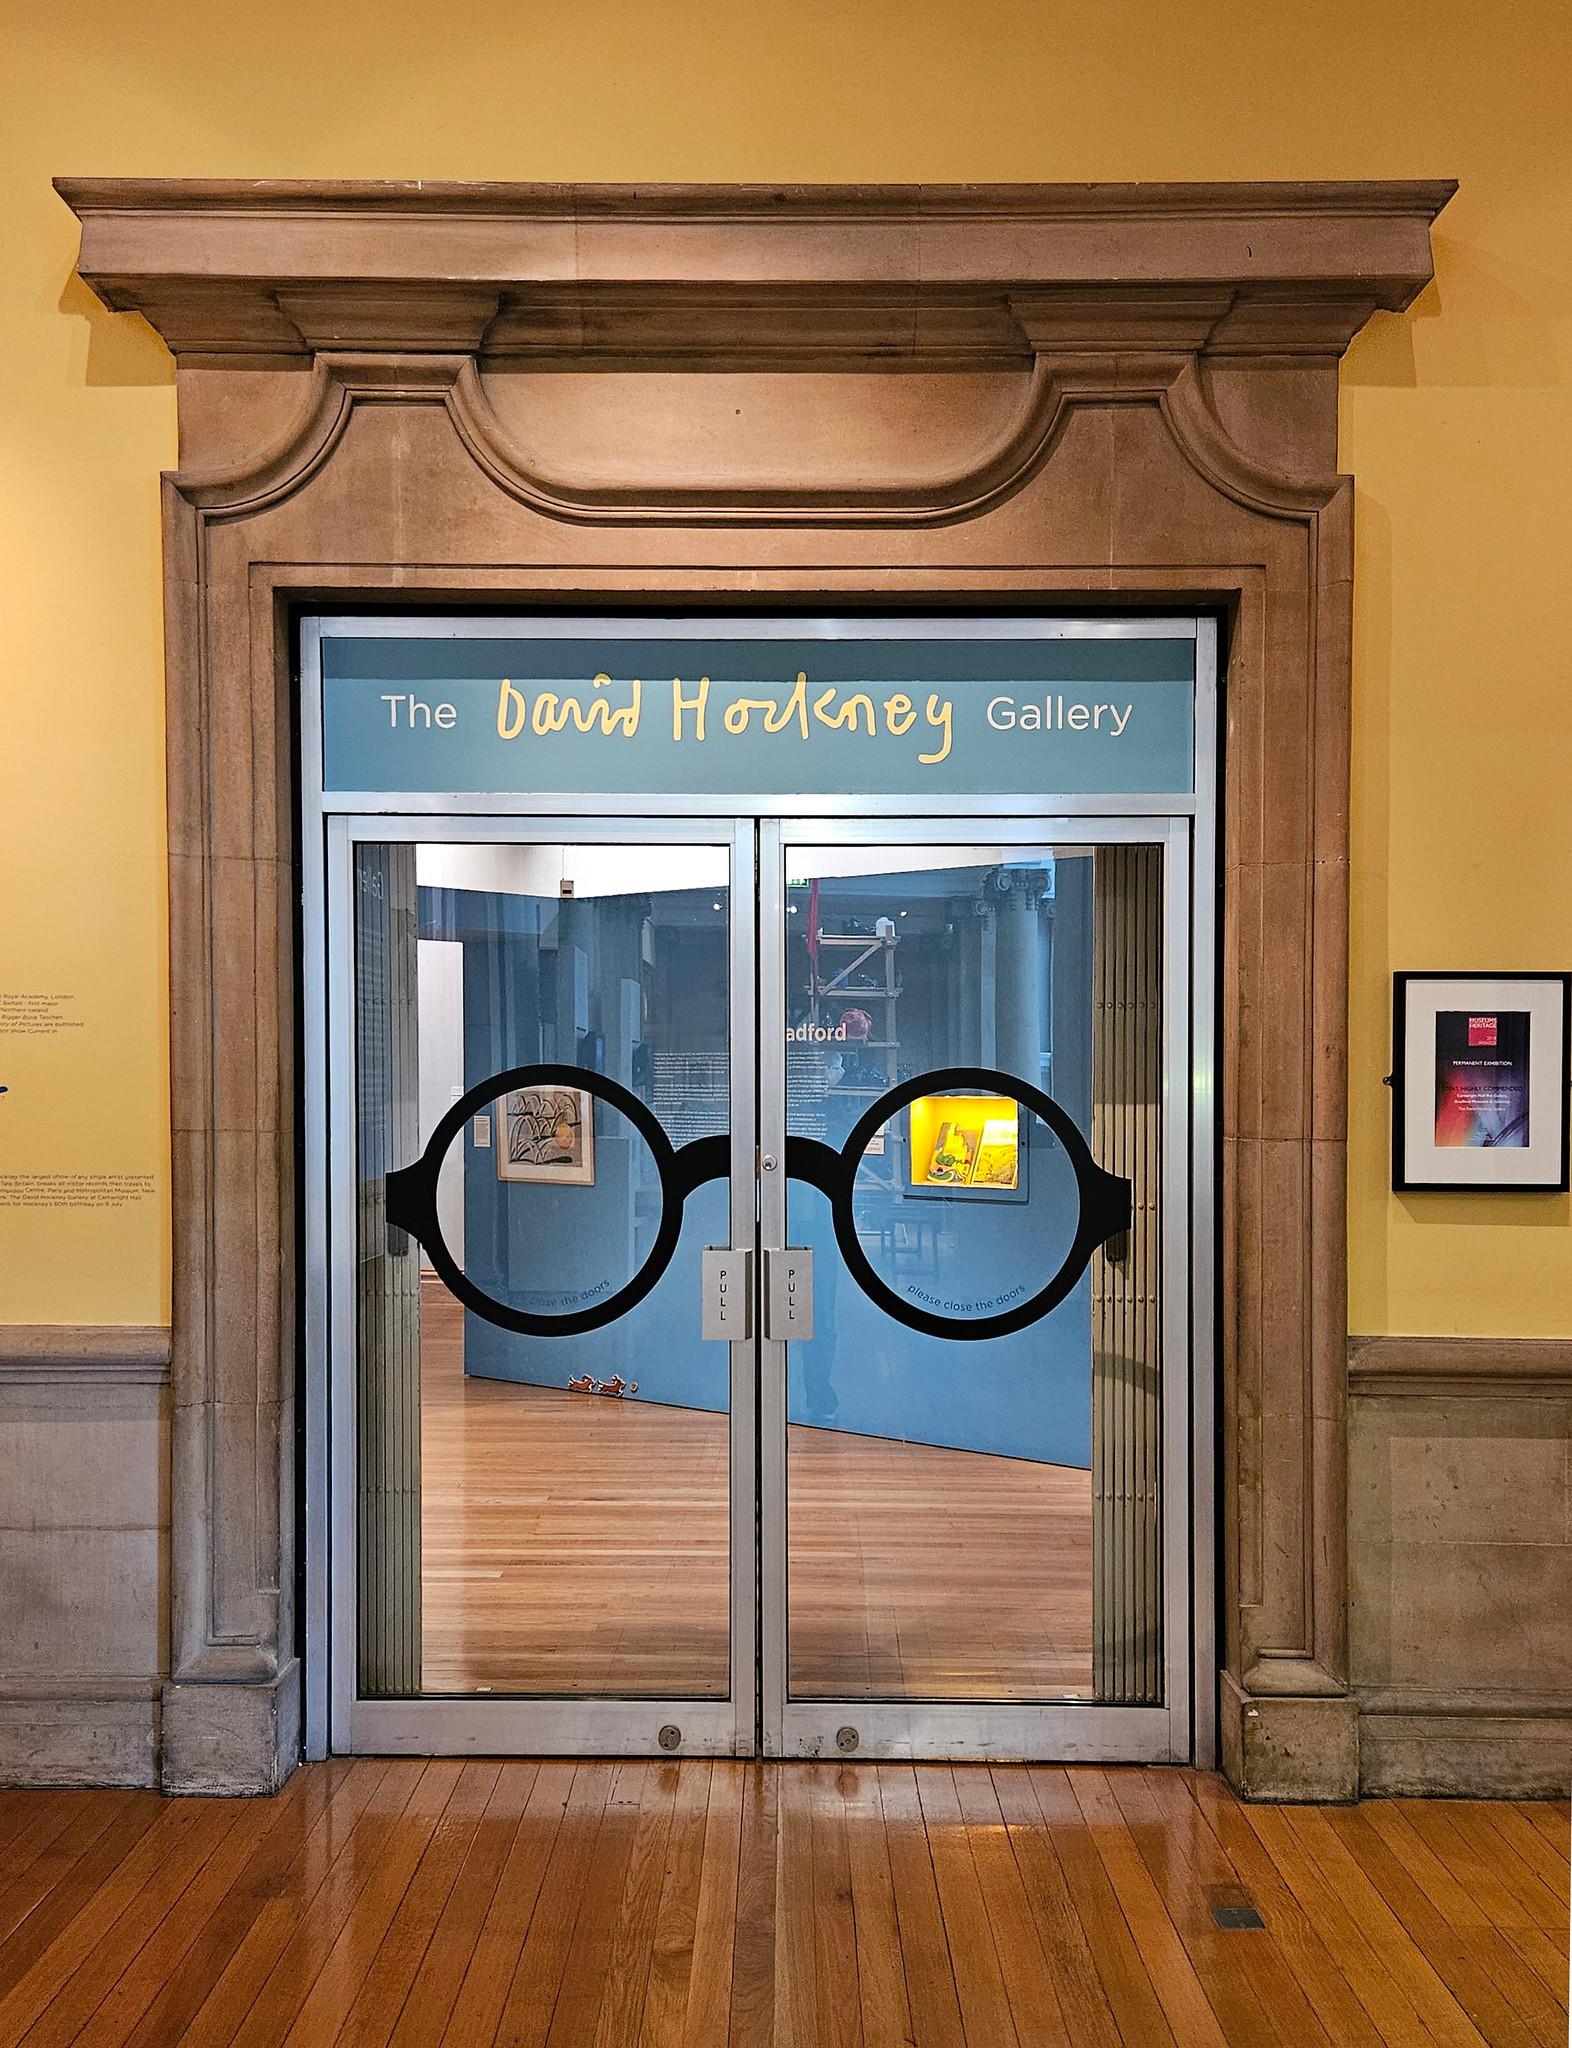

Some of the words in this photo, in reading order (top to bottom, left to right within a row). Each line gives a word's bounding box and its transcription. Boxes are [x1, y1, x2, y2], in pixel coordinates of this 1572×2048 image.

[381, 694, 458, 730] The
[496, 675, 643, 741] David
[986, 695, 1134, 738] Gallery
[561, 1295, 578, 1306] the
[581, 1279, 610, 1301] doors
[788, 1269, 796, 1320] PULL
[908, 1285, 941, 1307] please
[943, 1301, 973, 1312] close
[976, 1300, 994, 1311] the
[996, 1284, 1025, 1306] doors
